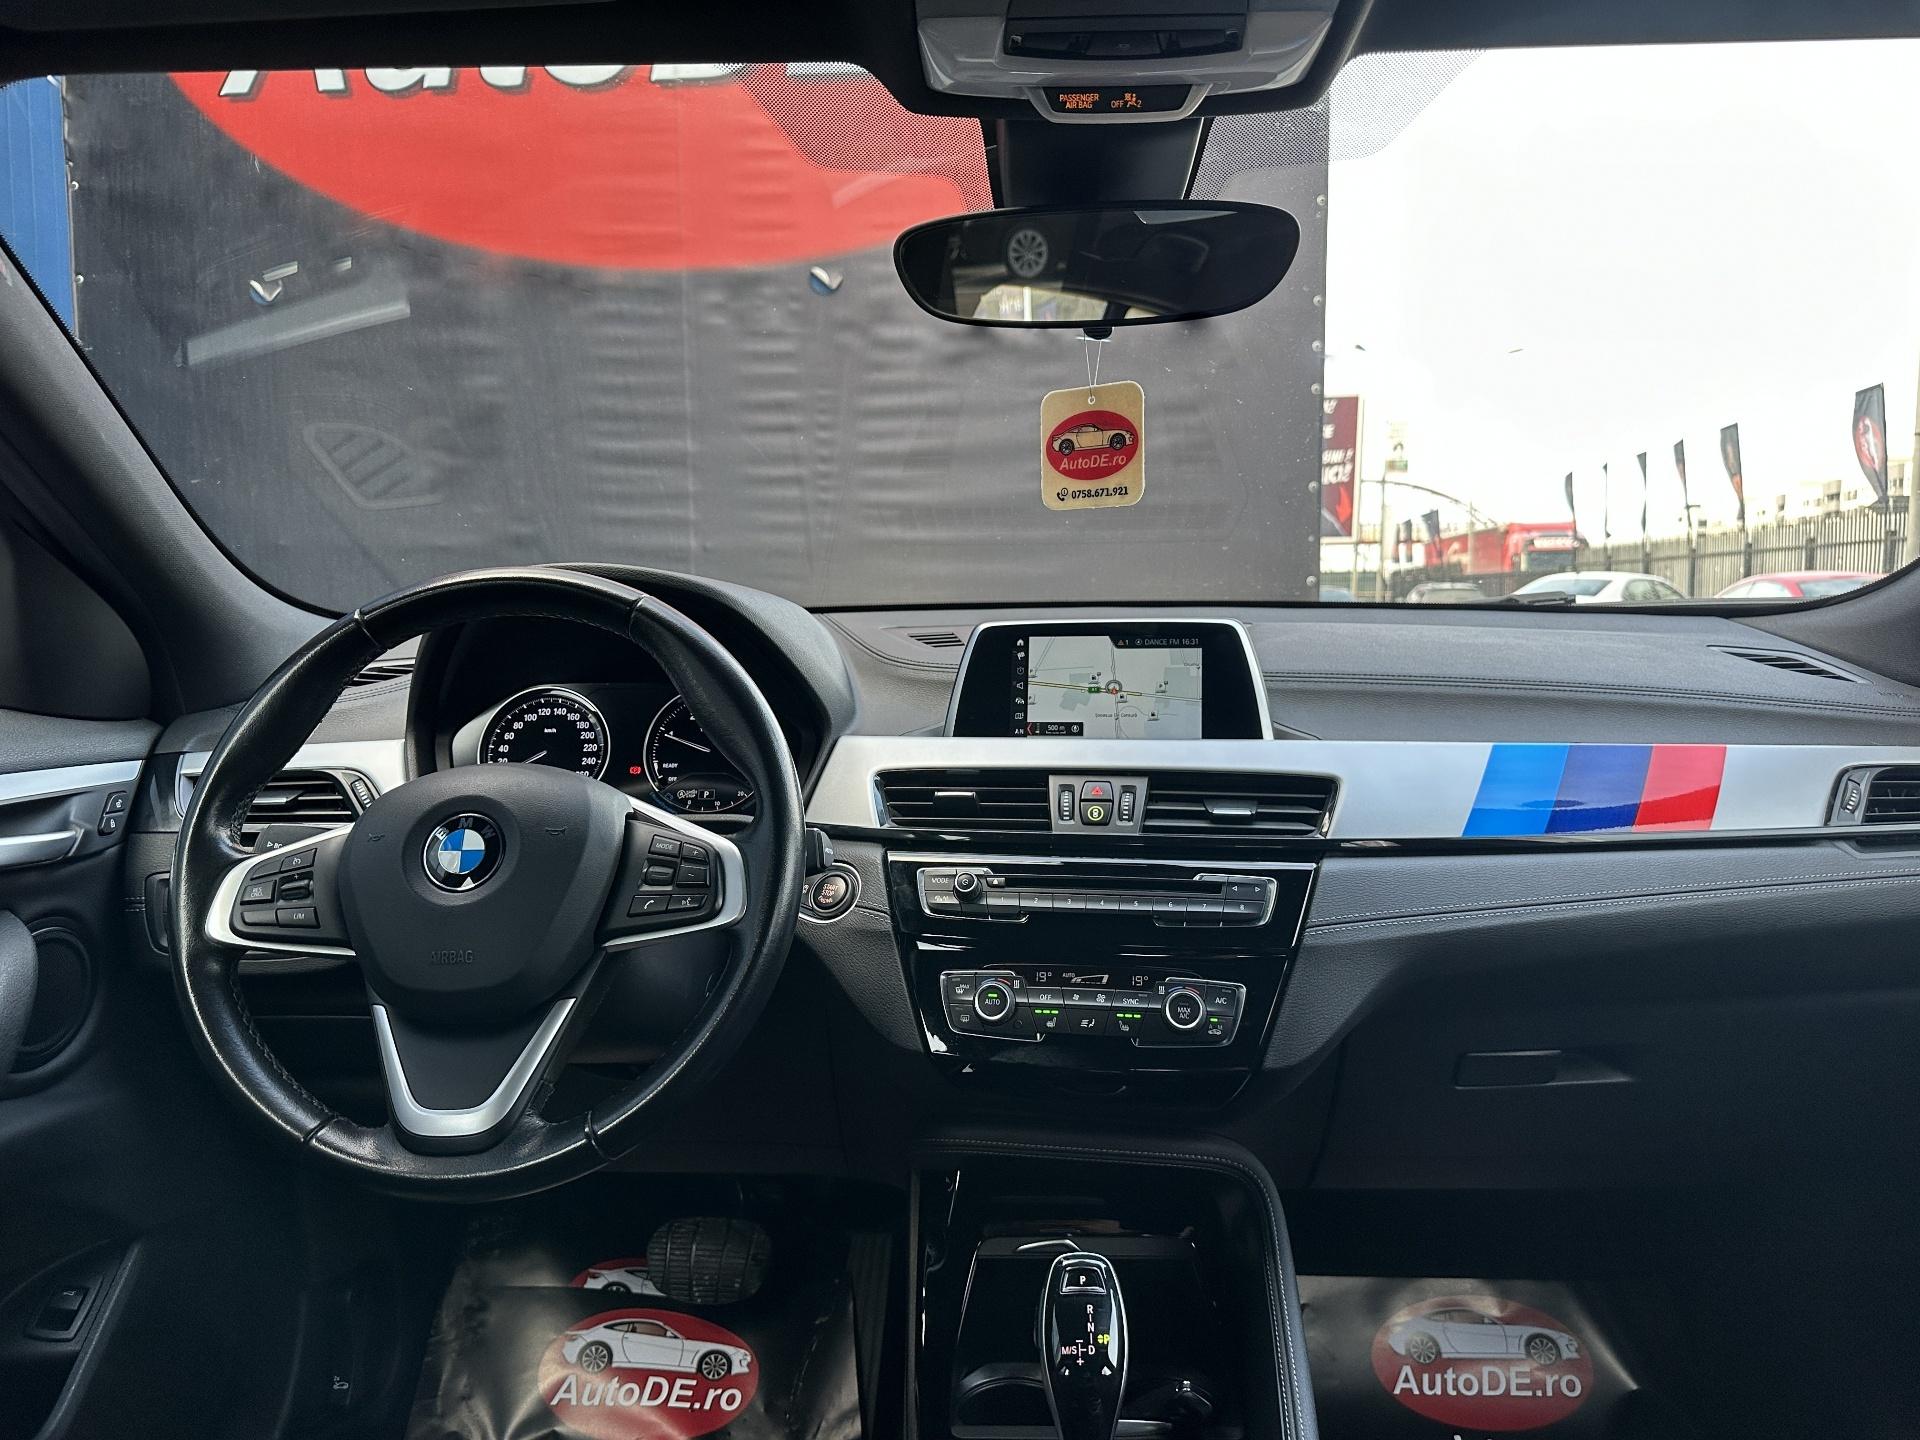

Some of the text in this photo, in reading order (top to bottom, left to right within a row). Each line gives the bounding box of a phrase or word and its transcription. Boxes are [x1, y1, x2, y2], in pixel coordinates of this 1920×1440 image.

[1065, 101, 1093, 109] AIR BAG
[1110, 100, 1124, 108] OFF
[1060, 453, 1127, 471] AutoDE.ro
[1071, 486, 1129, 499] 0758.671.921
[1144, 638, 1199, 646] DANCE FM 16:31
[538, 708, 551, 716] 120
[524, 713, 537, 721] 100
[567, 713, 580, 721] 160
[513, 721, 523, 729] 80
[576, 721, 590, 729] 180
[504, 732, 515, 740] 60
[580, 731, 595, 739] 200
[498, 744, 509, 752] 40
[583, 744, 598, 752] 220
[581, 757, 597, 765] 240
[435, 817, 497, 841] BMW
[655, 842, 675, 851] MODE
[984, 998, 1000, 1006] AUTO
[1215, 997, 1227, 1005] A/C
[1080, 1275, 1087, 1285] P
[1086, 1304, 1094, 1314] R
[1087, 1322, 1095, 1332] N
[1061, 1345, 1077, 1355] M/S
[1088, 1345, 1096, 1355] D
[1393, 1364, 1583, 1398] AutoDE.ro
[550, 1374, 742, 1412] AutoDE.ro
